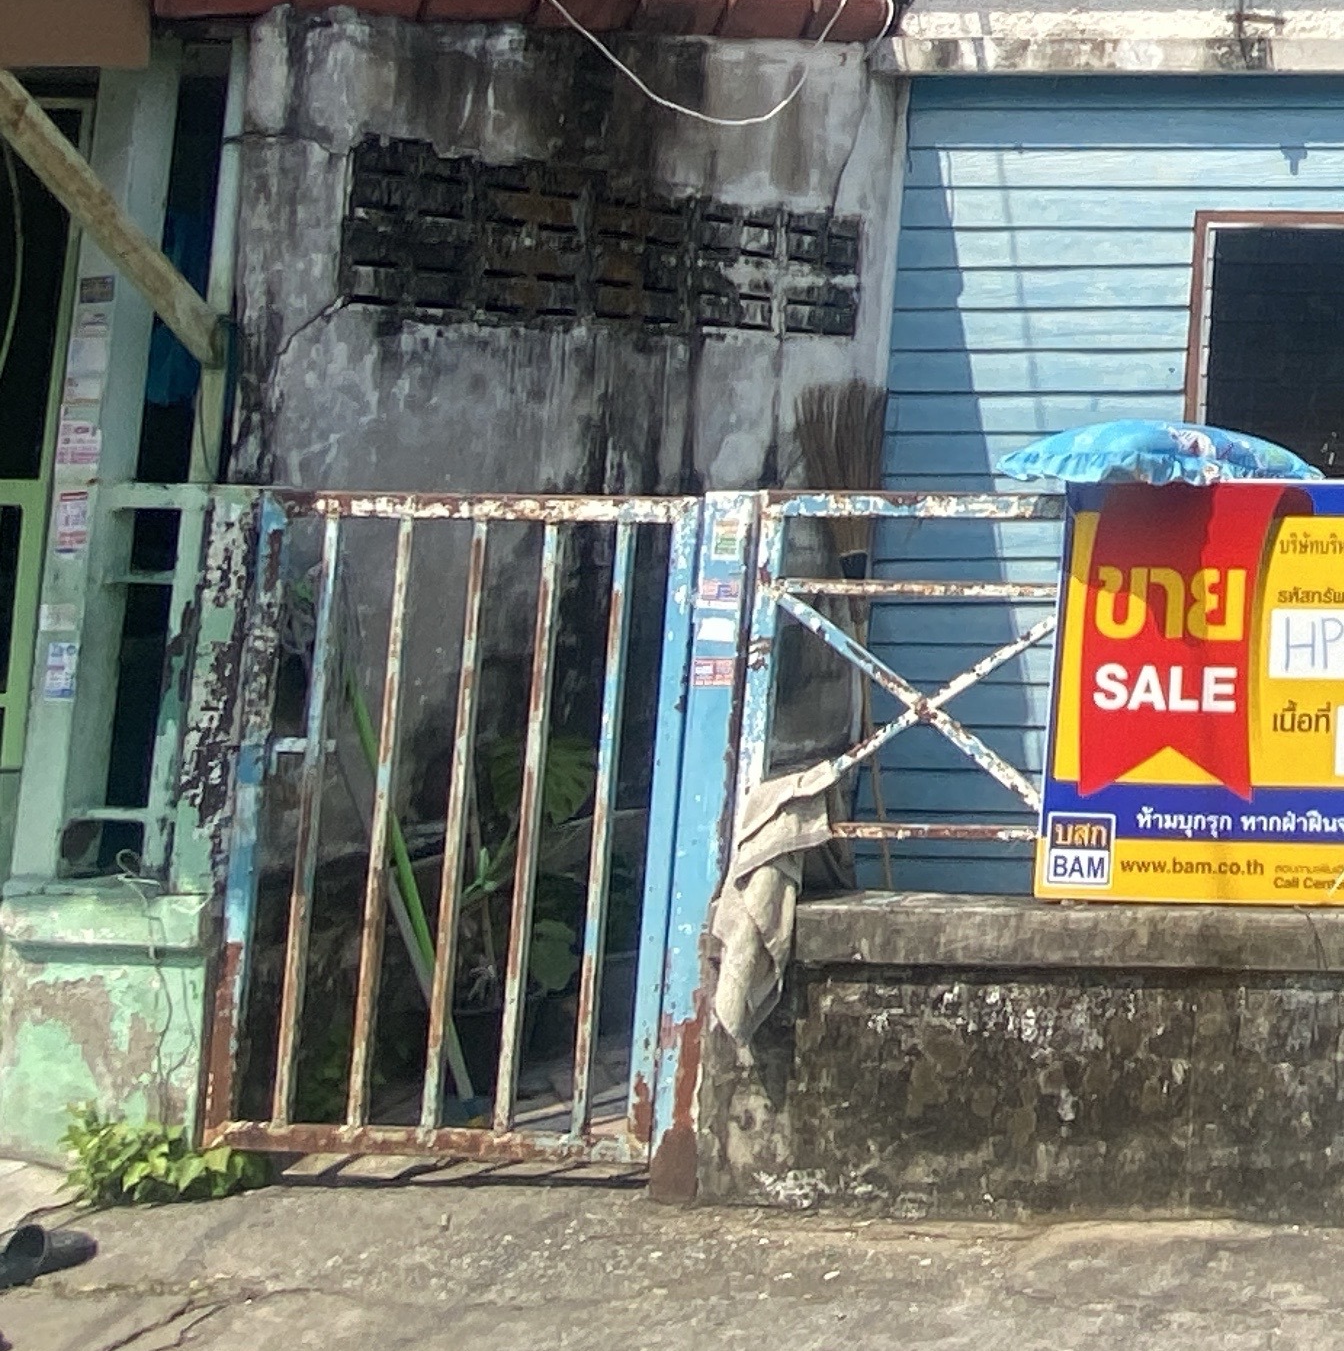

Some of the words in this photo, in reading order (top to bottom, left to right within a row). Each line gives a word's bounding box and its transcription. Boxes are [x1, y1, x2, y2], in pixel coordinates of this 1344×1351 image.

[1095, 565, 1247, 641] ขาย
[1093, 662, 1238, 713] SALE
[1271, 700, 1332, 734] เนื้อที่
[1055, 821, 1108, 846] บสก
[1136, 806, 1233, 838] ห้ามบุกรุก
[1053, 854, 1106, 879] BAM
[1120, 857, 1265, 877] www.bam.co.th
[1273, 876, 1300, 889] Call
